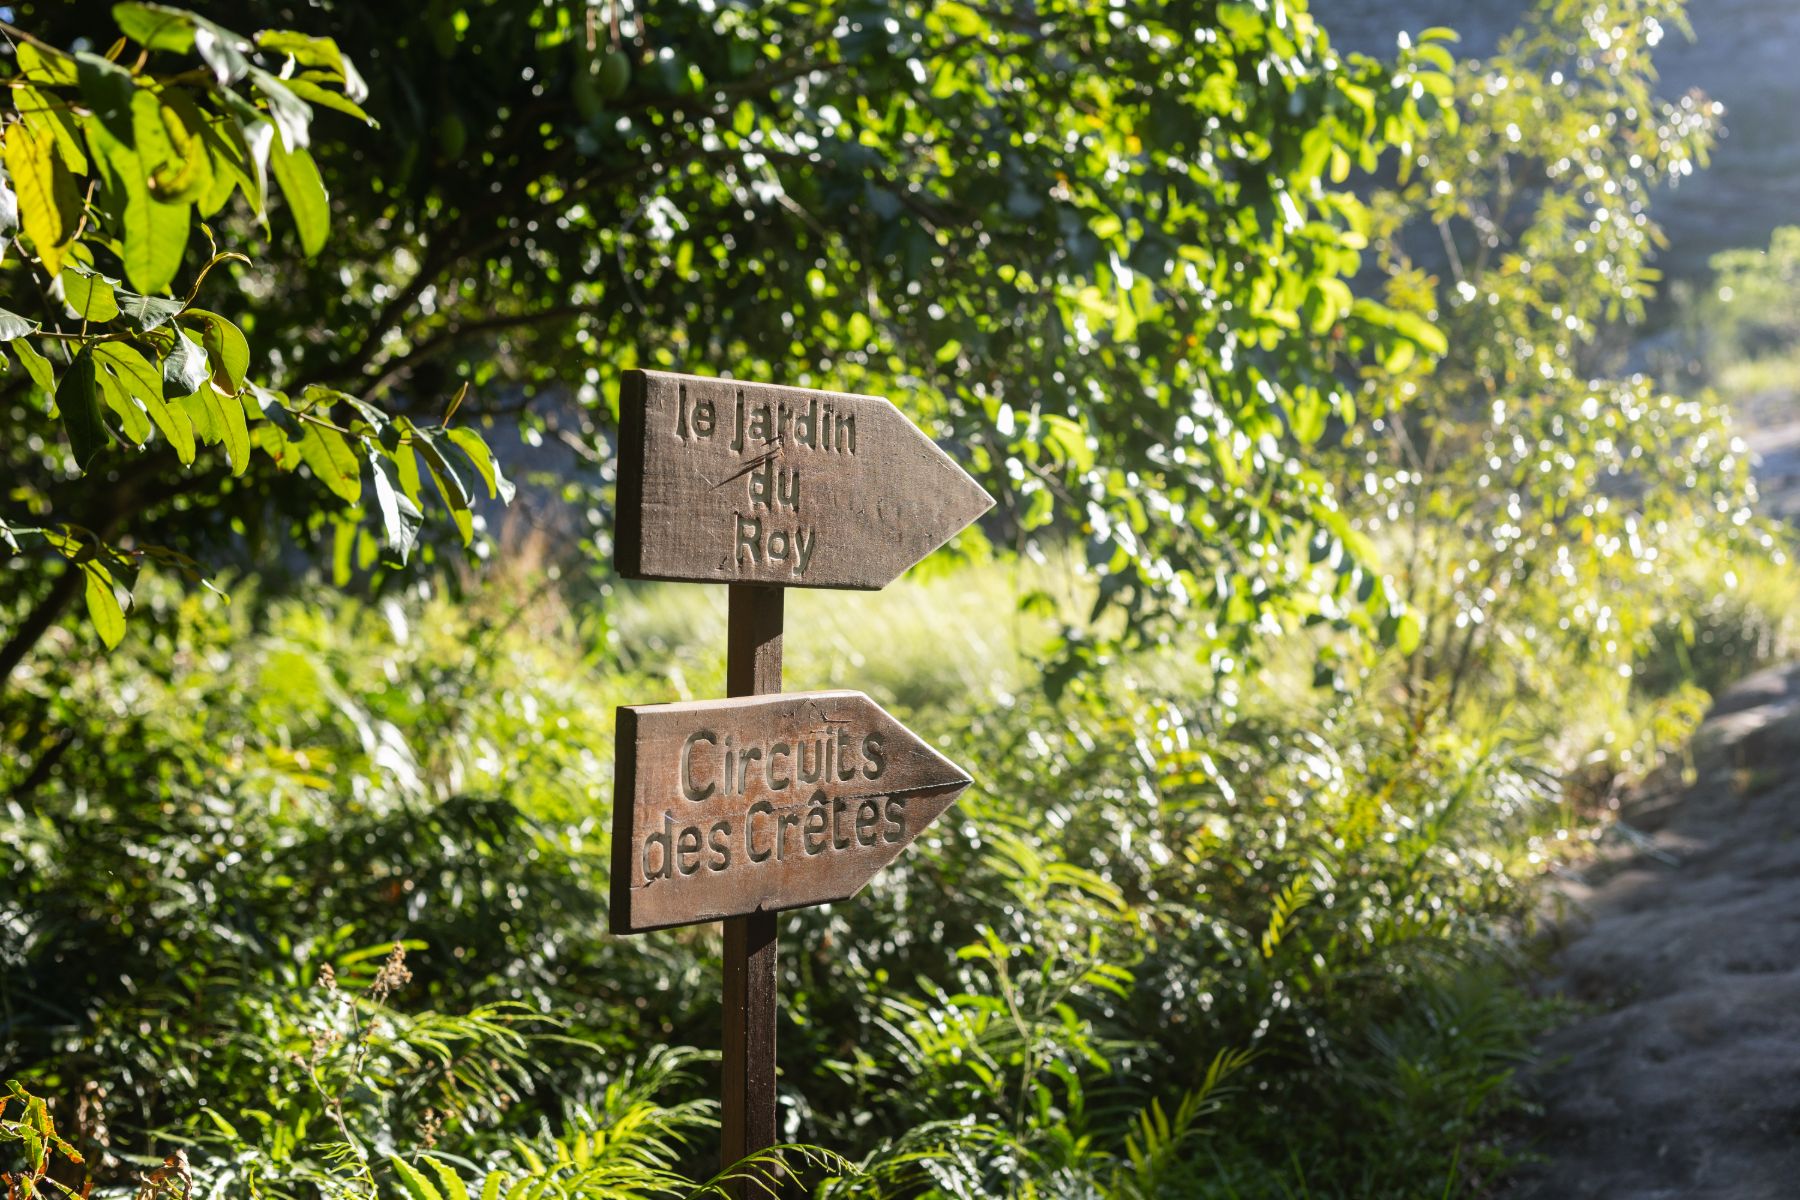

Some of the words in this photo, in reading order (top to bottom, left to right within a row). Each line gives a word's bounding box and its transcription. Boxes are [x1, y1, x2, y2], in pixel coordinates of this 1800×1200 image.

[676, 384, 716, 447] le
[748, 454, 801, 512] du
[734, 511, 816, 577] Roy
[681, 726, 887, 801] Circuits
[641, 809, 732, 882] des
[745, 789, 907, 864] Crêtes
